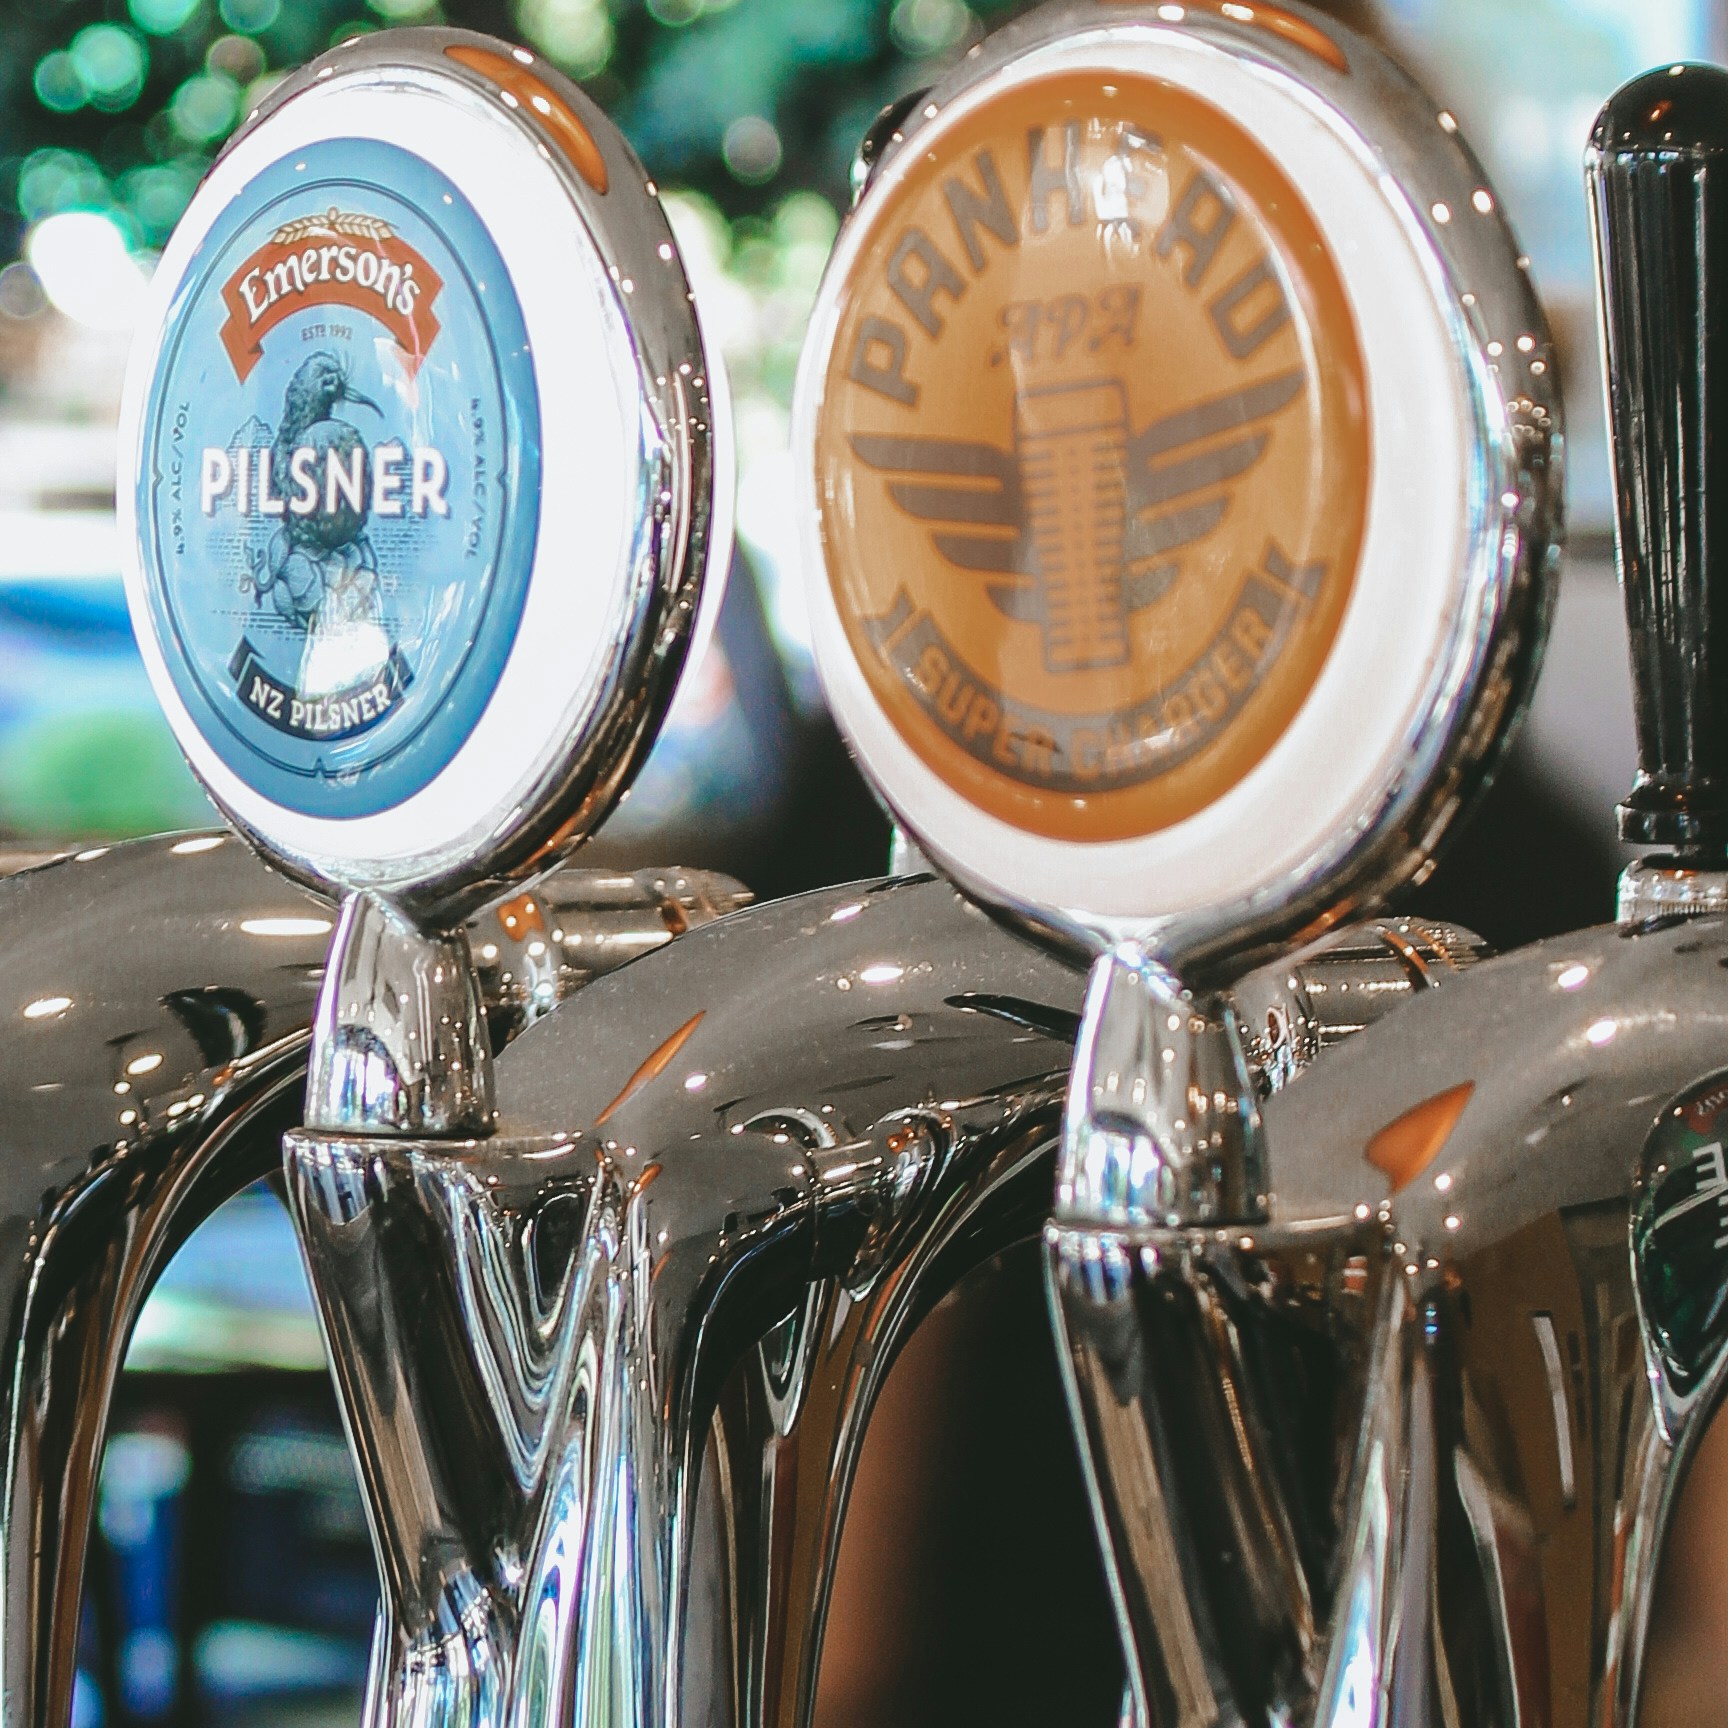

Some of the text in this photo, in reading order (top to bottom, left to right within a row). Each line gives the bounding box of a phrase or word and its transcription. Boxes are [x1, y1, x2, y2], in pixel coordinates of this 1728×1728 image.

[239, 246, 420, 324] Emerson's
[171, 401, 189, 501] ALC/VOL
[201, 447, 450, 517] PILSNER
[249, 676, 391, 731] NZ PILSNER
[918, 645, 1056, 778] SUPER
